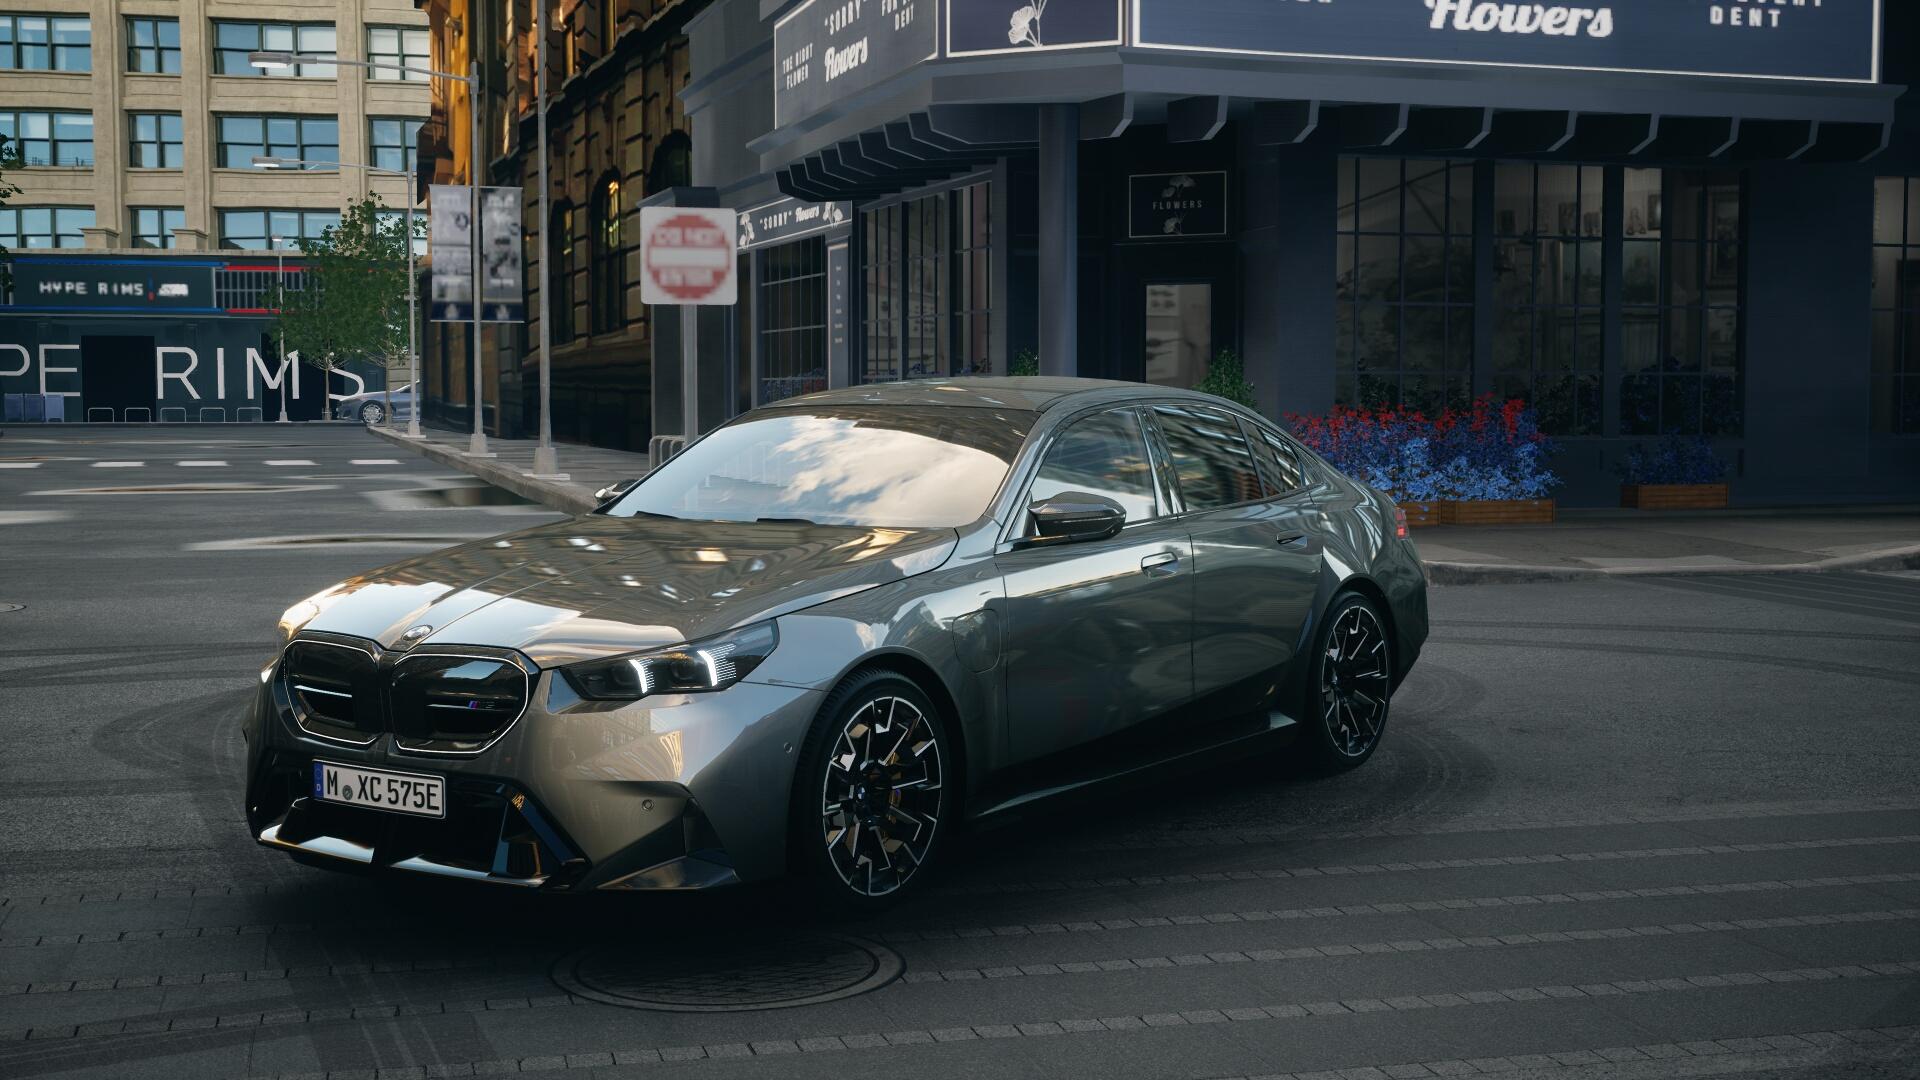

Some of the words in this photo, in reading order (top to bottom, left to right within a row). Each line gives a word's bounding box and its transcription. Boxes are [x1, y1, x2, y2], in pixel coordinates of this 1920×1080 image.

[895, 3, 914, 31] DENT
[1710, 5, 1780, 27] DENT
[783, 55, 793, 74] THE
[786, 63, 809, 90] FLOWER
[1152, 199, 1203, 210] FLOWERS
[39, 281, 88, 295] HYPE
[97, 282, 144, 297] RIMS
[316, 783, 321, 792] D
[326, 769, 338, 796] M
[357, 774, 382, 803] XC
[387, 778, 440, 811] 575E
